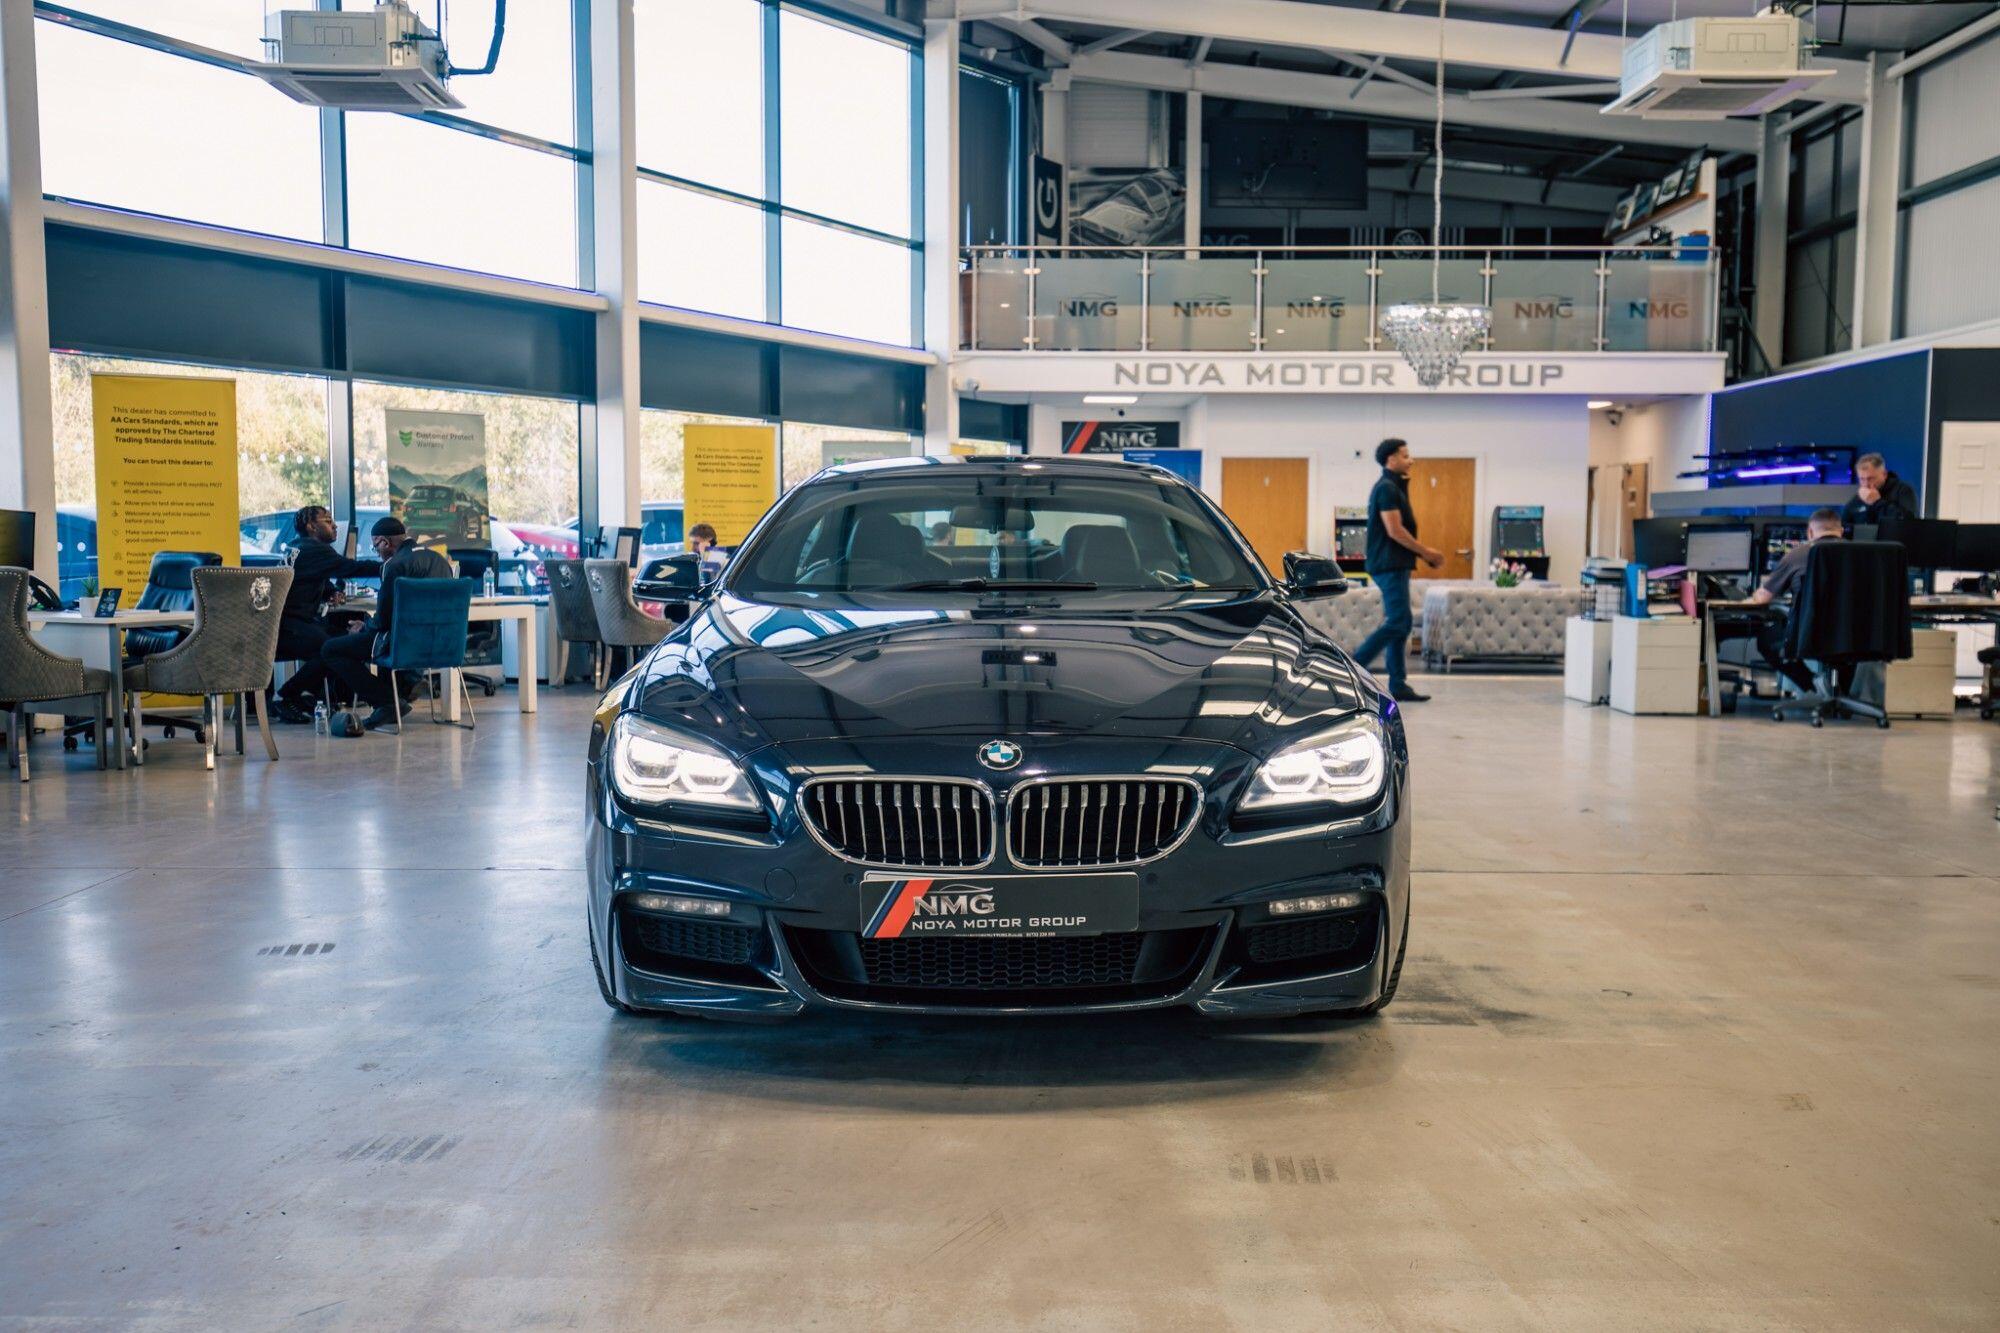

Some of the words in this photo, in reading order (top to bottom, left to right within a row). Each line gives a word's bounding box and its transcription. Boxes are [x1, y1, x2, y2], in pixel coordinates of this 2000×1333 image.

[1059, 301, 1118, 317] NMG
[1173, 301, 1232, 317] NMG
[1287, 302, 1346, 318] NMG
[1515, 302, 1574, 318] NMG
[1629, 302, 1688, 318] NMG
[1115, 363, 1225, 385] NOYA
[1246, 363, 1395, 386] MOTOR
[113, 406, 128, 414] This
[130, 407, 152, 415] dealer
[154, 407, 167, 415] has
[168, 408, 207, 417] committed
[123, 416, 140, 424] Cars
[142, 417, 182, 426] Standards,
[184, 418, 206, 426] which
[115, 427, 151, 435] approved
[152, 427, 161, 435] by
[163, 427, 177, 435] The
[178, 428, 215, 436] Chartered
[416, 431, 449, 440] Customer
[450, 432, 474, 441] Protect
[114, 436, 143, 444] Trading
[144, 437, 182, 445] Standards
[183, 438, 217, 446] Institute.
[1100, 432, 1157, 447] NMG
[913, 894, 996, 917] NMG
[912, 920, 957, 931] NOYA
[963, 918, 1022, 929] MOTOR
[1028, 916, 1087, 927] GROUP
